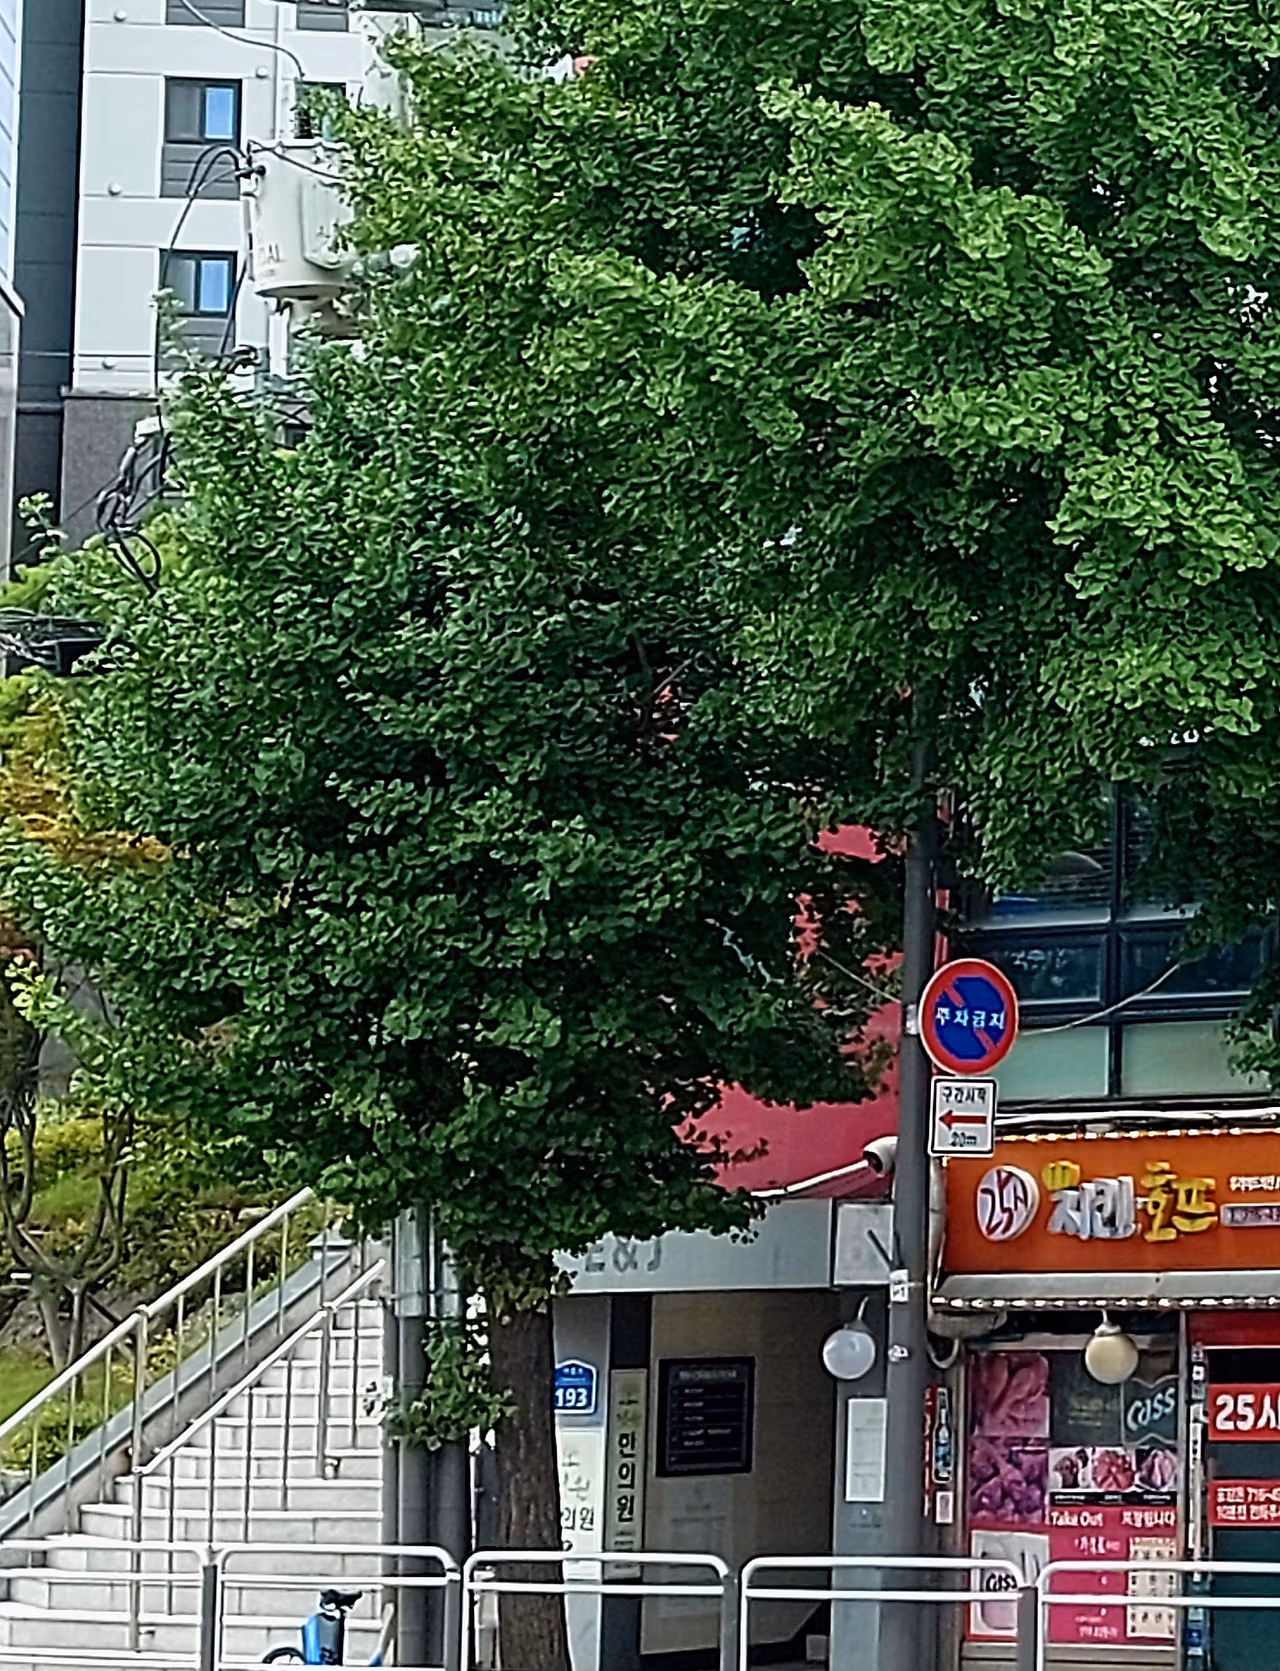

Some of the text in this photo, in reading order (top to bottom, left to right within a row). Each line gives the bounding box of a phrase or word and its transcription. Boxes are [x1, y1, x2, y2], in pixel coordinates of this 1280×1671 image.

[936, 1005, 1004, 1029] 주차금지
[951, 1132, 977, 1147] 20m
[555, 1388, 588, 1408] 193
